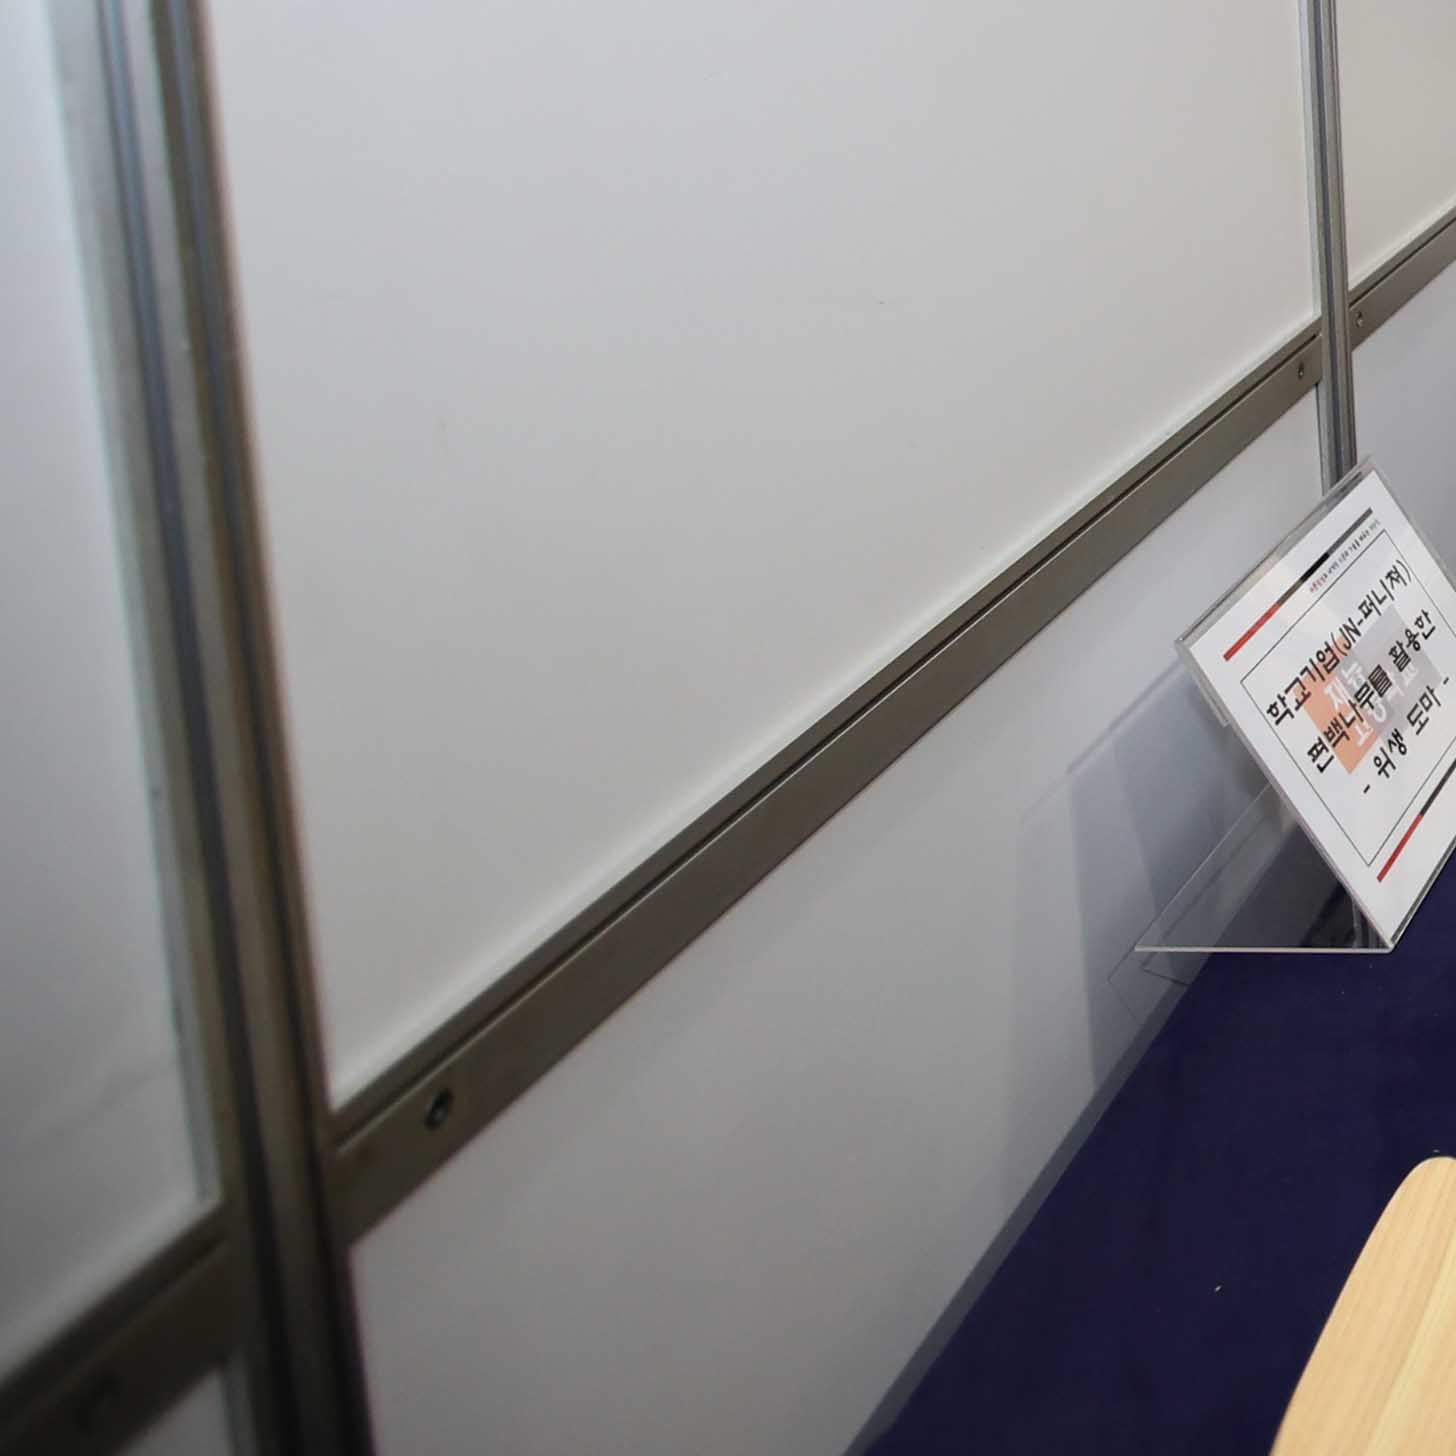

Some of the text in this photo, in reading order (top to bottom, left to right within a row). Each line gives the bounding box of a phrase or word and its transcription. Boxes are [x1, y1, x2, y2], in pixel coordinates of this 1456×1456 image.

[1307, 664, 1393, 773] 편백나무를
[1388, 609, 1436, 673] 활용한
[1373, 728, 1407, 779] 위생
[1406, 685, 1442, 736] 도마
